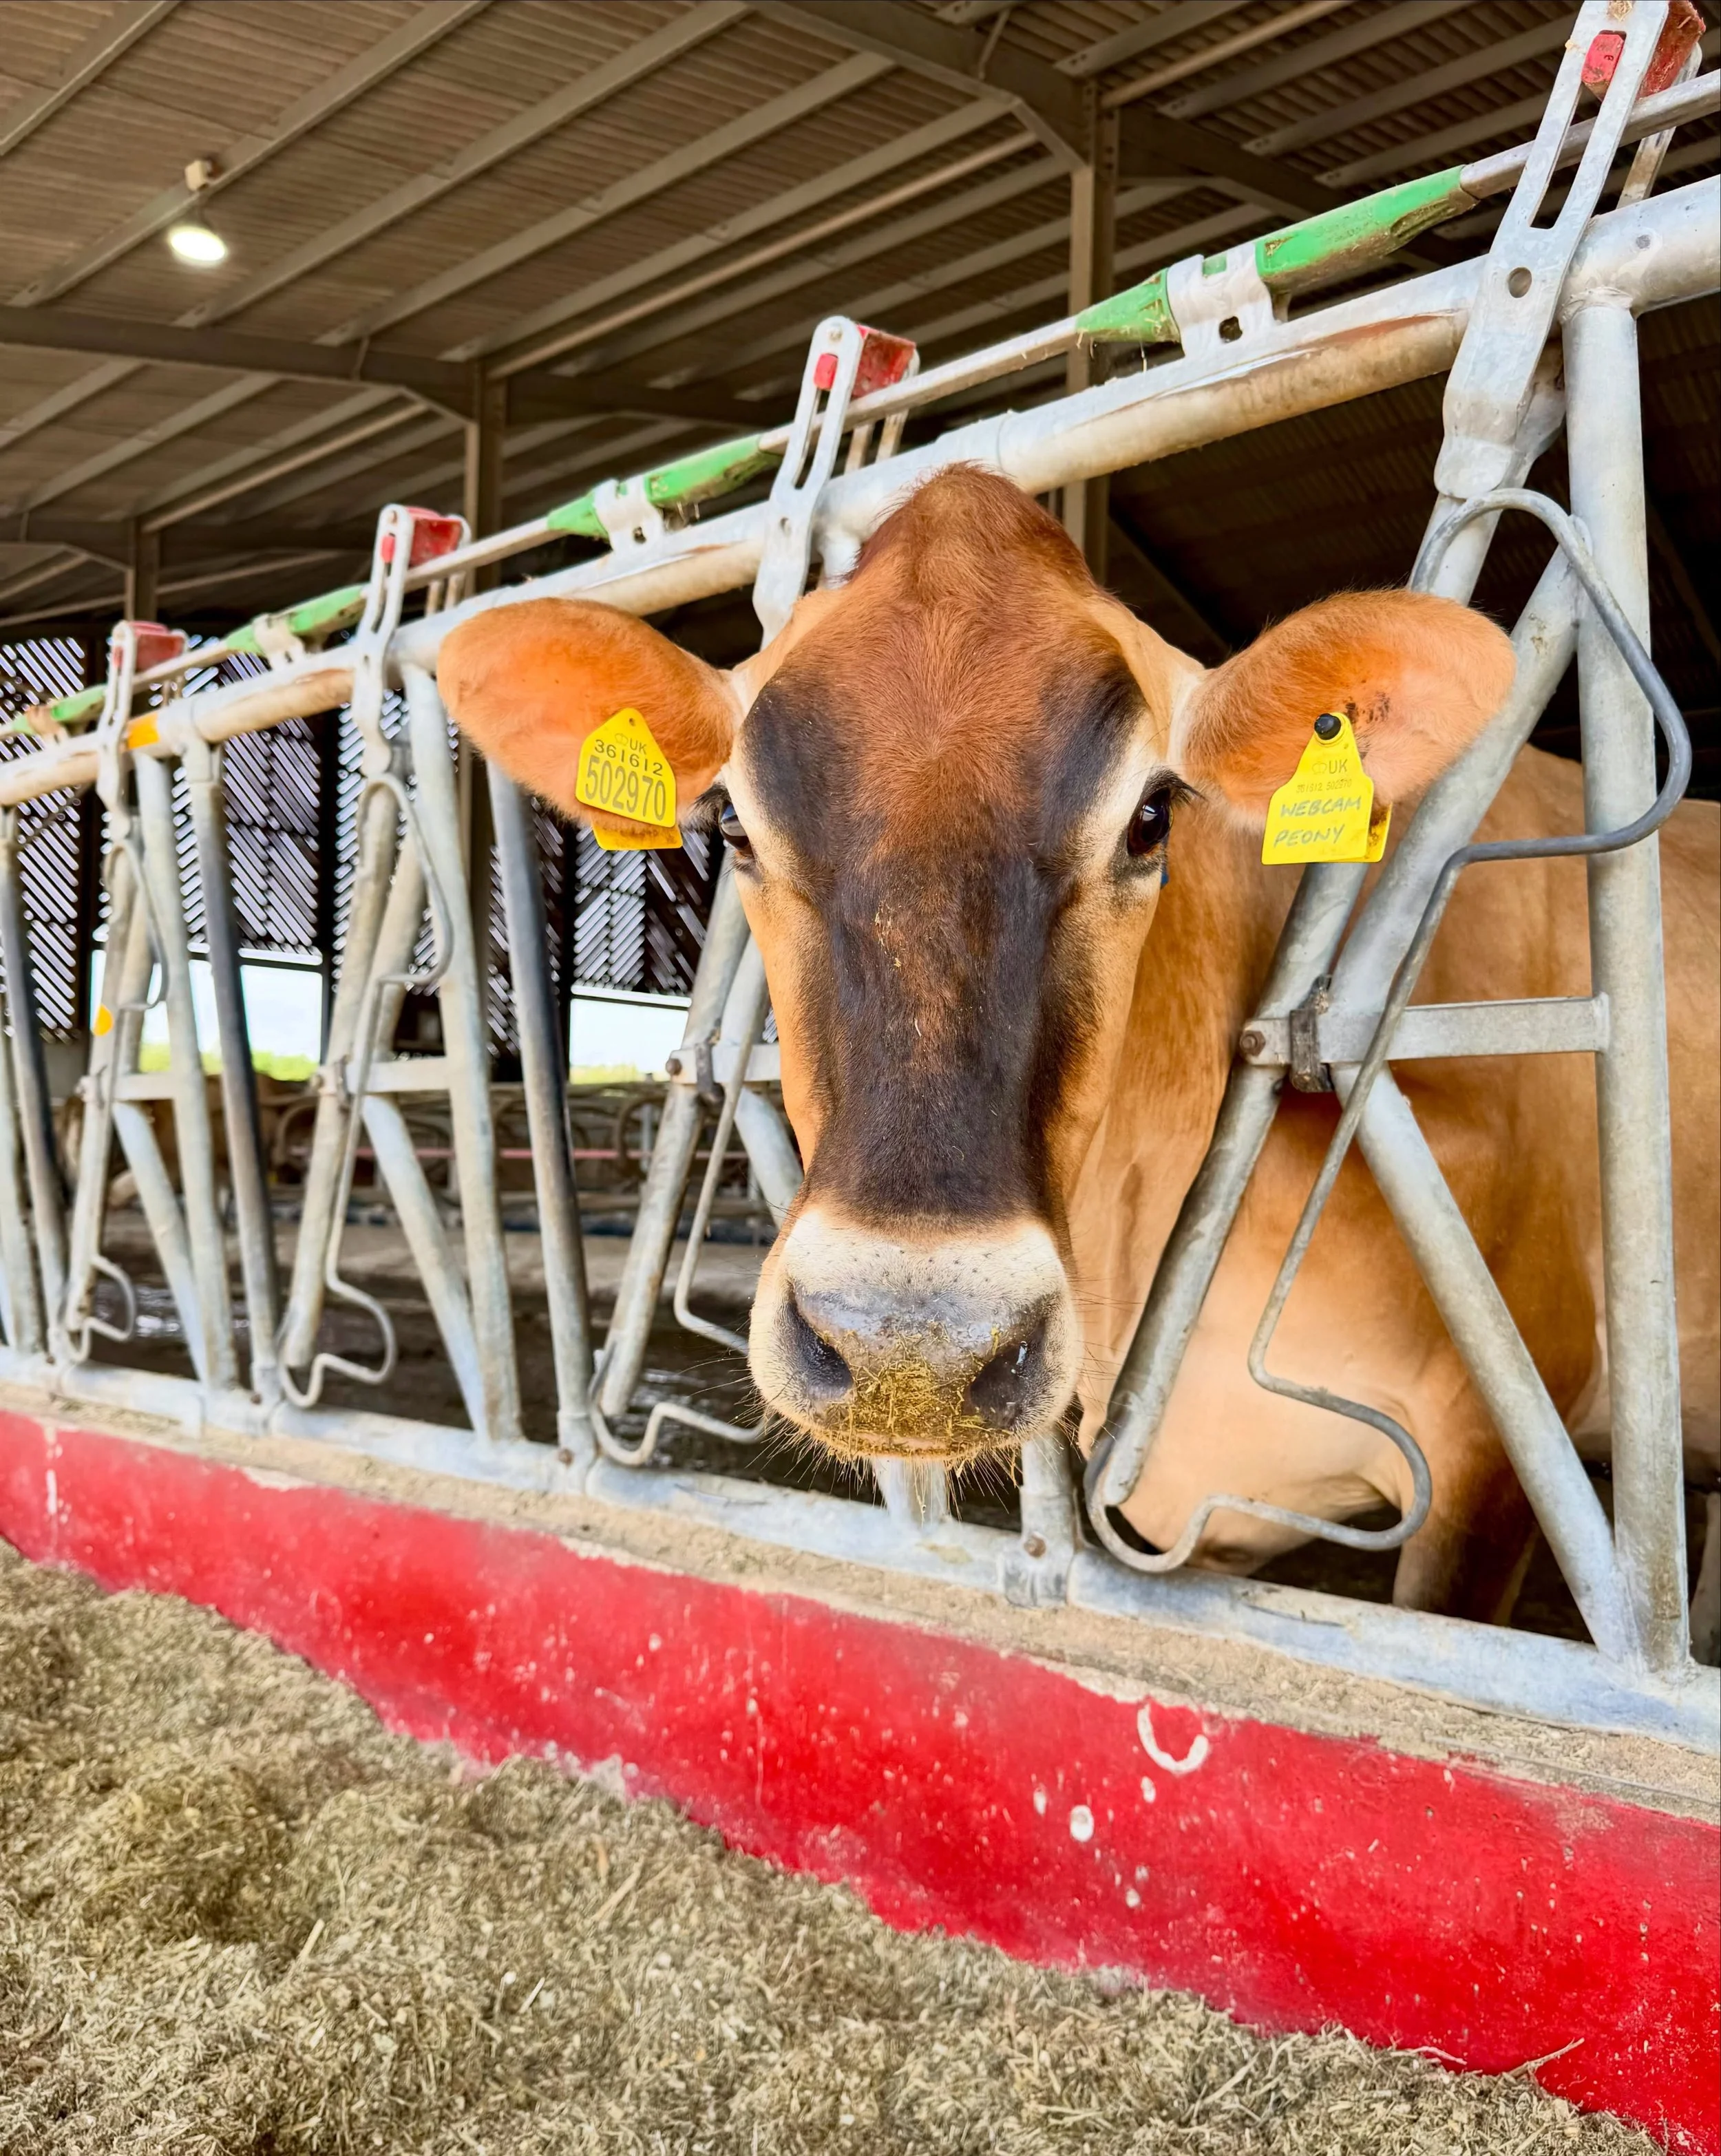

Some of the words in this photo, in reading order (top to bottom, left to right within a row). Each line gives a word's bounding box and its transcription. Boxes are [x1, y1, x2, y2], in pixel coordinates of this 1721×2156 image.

[594, 739, 663, 776] 361612
[629, 739, 647, 754] UK
[1329, 759, 1348, 774] UK
[585, 754, 666, 821] 502970
[1280, 796, 1362, 818] WEBCAM
[1274, 824, 1345, 848] PEONY
